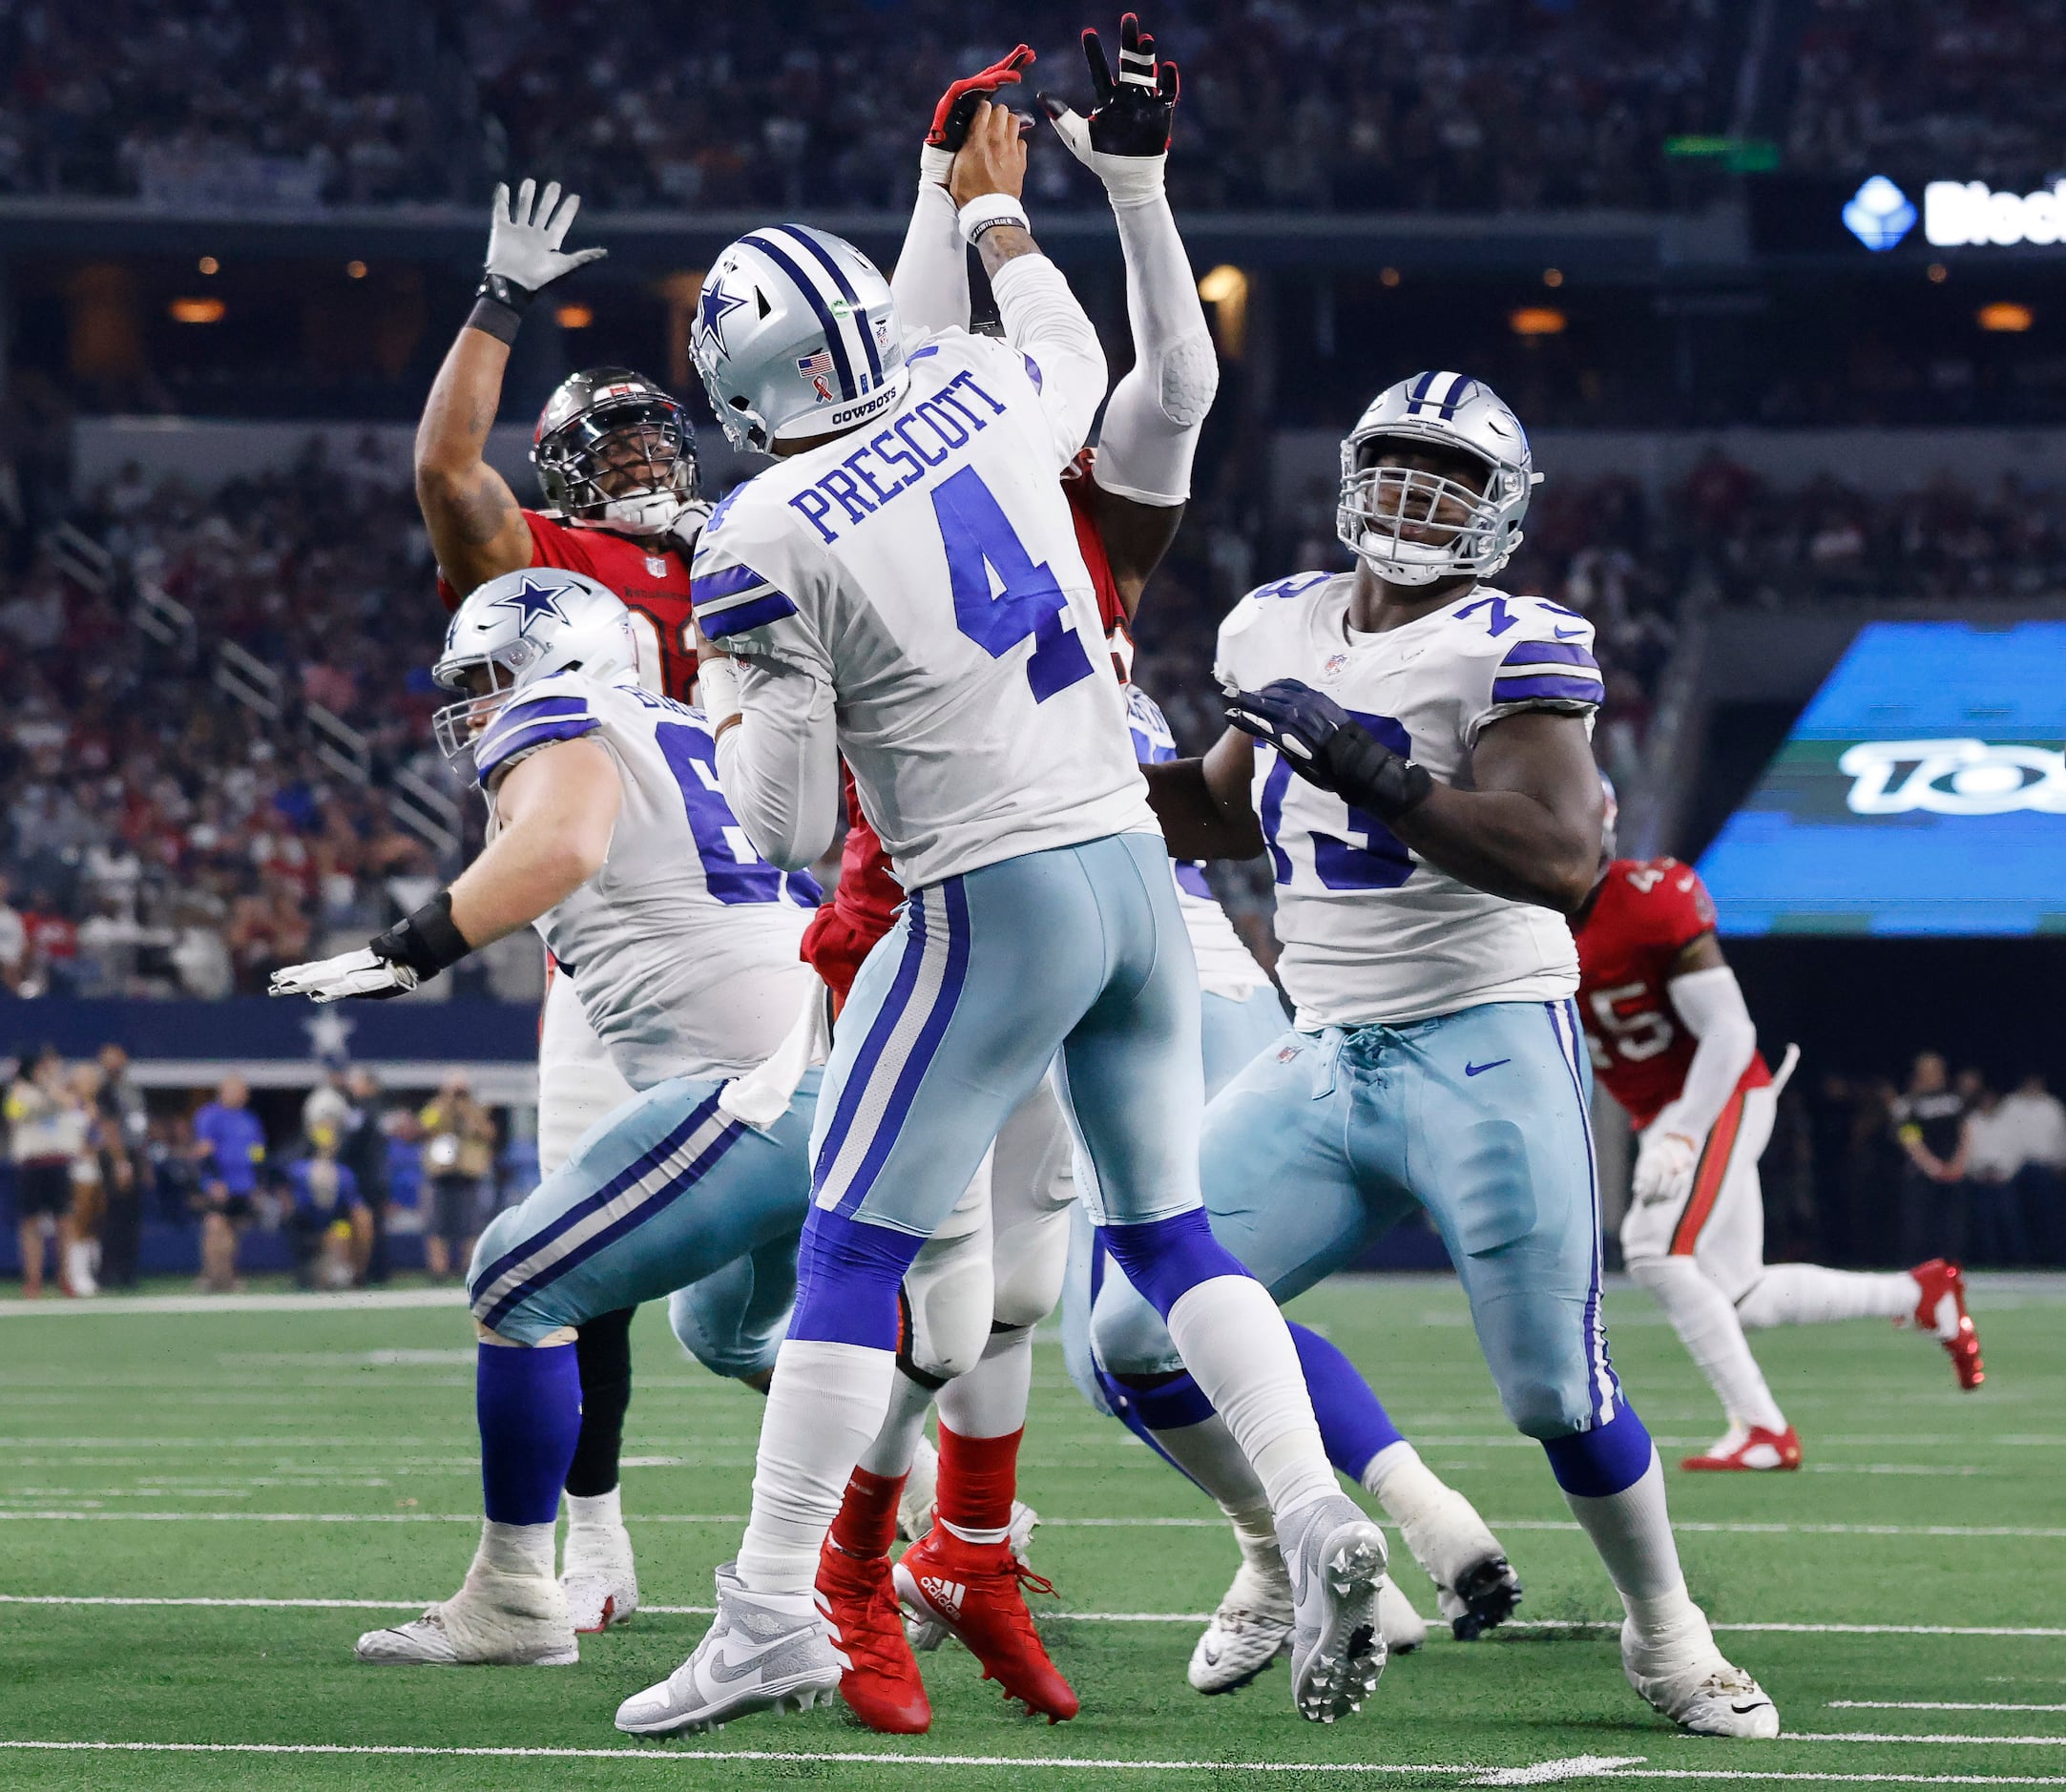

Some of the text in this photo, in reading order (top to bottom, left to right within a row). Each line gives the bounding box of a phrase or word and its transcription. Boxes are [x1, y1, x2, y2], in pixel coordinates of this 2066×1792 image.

[788, 370, 1007, 545] PRESCOTT
[832, 385, 897, 426] COWBOYS
[929, 464, 1096, 705] 4
[655, 720, 825, 908] 6
[920, 1576, 962, 1620] adidas
